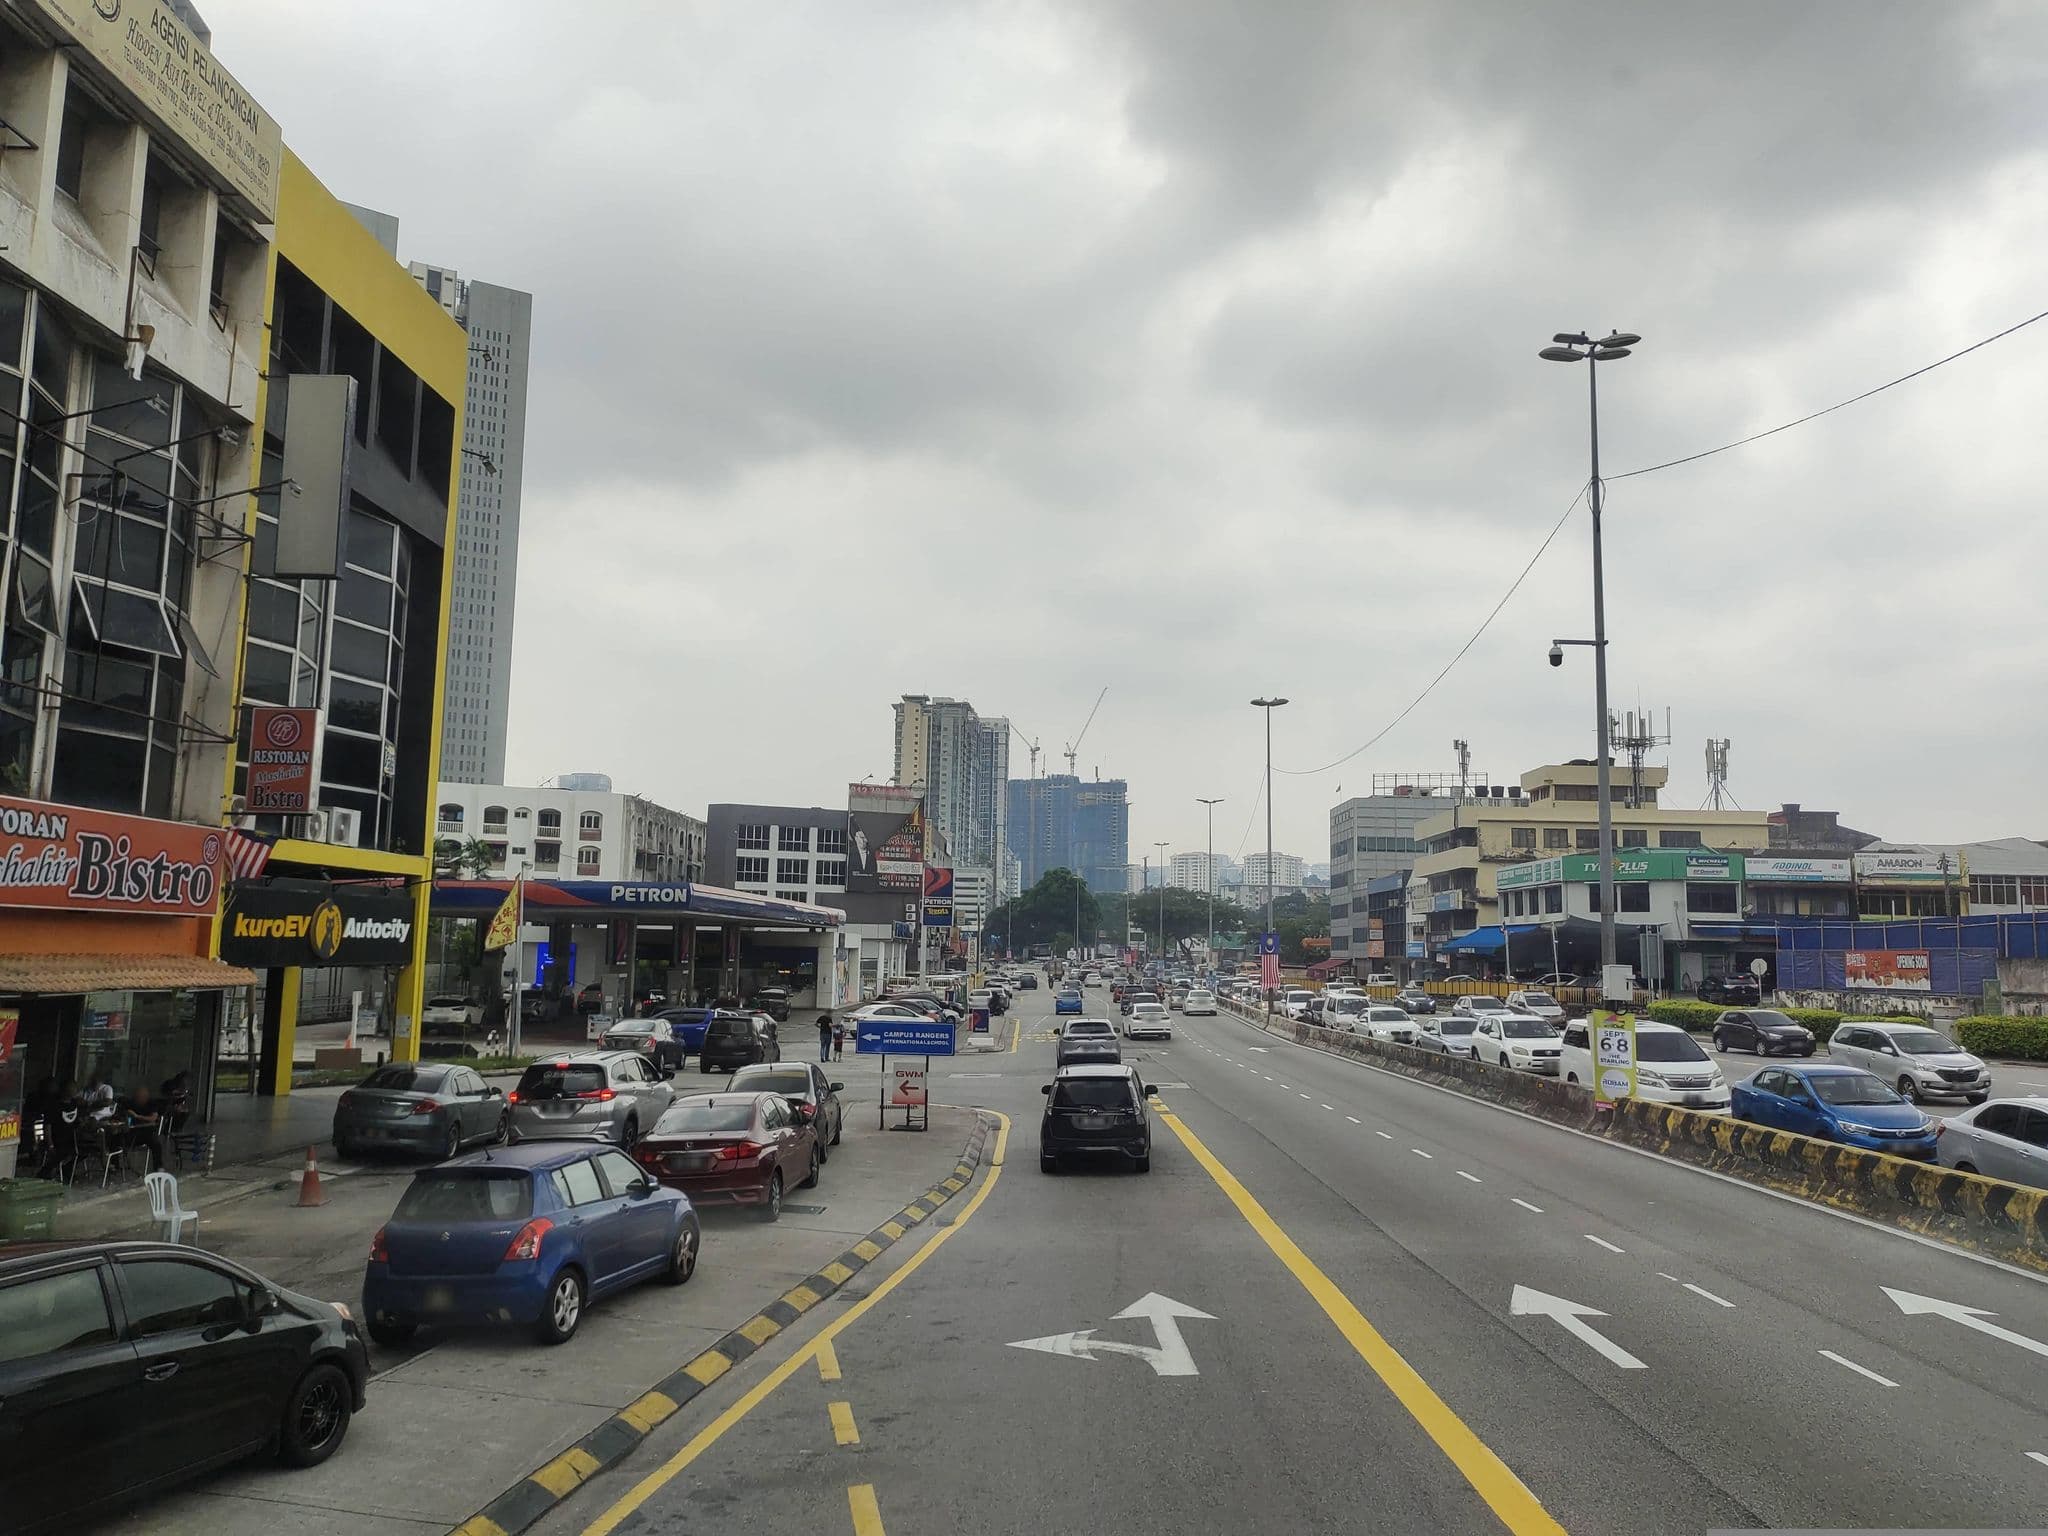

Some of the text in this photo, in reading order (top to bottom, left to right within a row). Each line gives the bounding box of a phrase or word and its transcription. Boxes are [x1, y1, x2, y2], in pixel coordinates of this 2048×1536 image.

[126, 18, 162, 67] HIDDEN
[151, 8, 189, 64] AGENSI
[193, 48, 259, 135] PELANCONGAN
[254, 751, 310, 764] RESTORAN
[252, 786, 304, 808] Bistro
[68, 832, 215, 907] Bistro
[1877, 858, 1922, 868] AMARON
[611, 885, 688, 903] PETRON
[234, 911, 410, 944] kuroEV Autocity
[1600, 1057, 1630, 1065] STARLING
[895, 1070, 924, 1078] GWM
